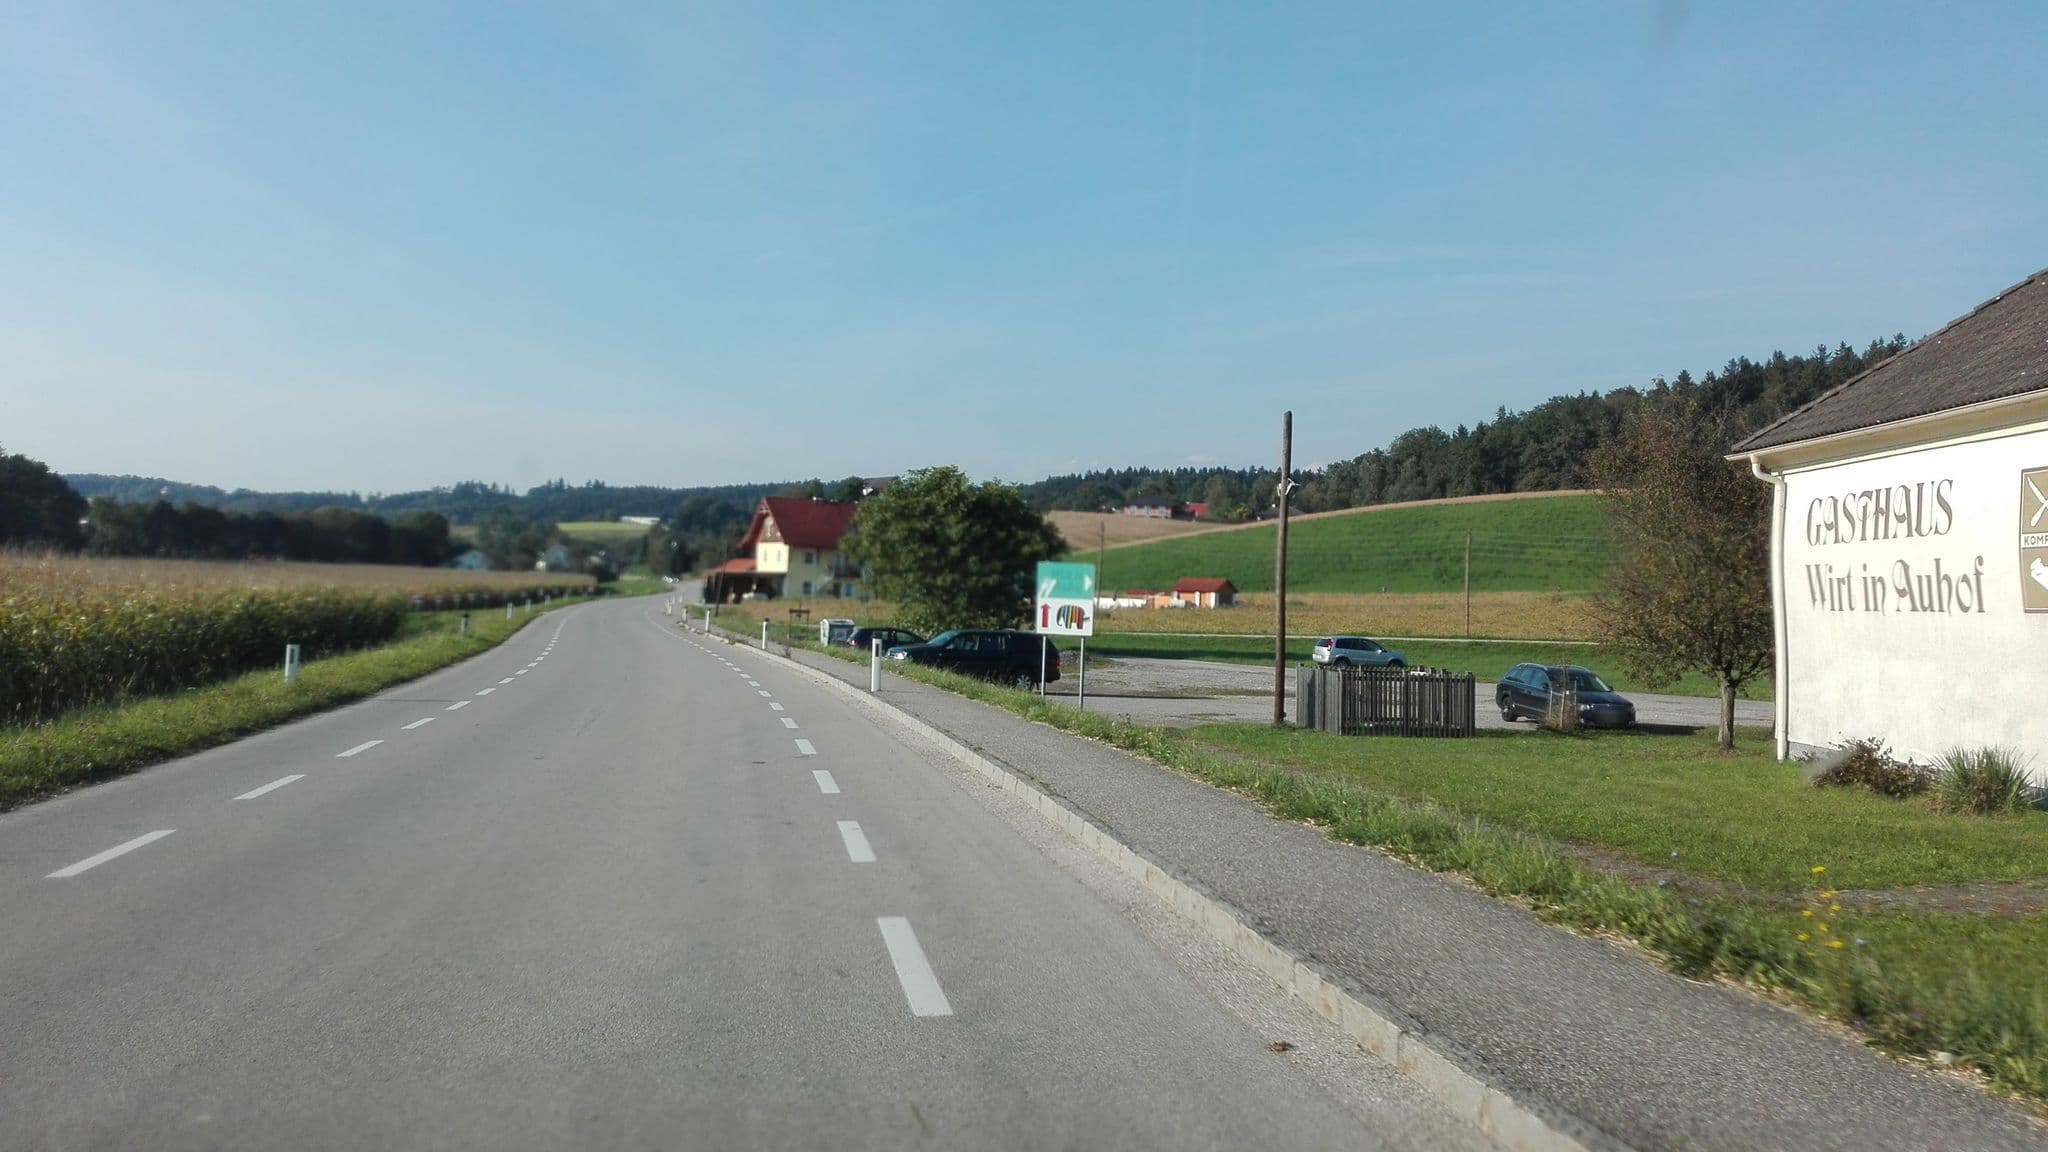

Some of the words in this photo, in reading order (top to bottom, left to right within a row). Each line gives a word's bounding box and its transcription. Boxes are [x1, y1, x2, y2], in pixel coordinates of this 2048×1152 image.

[1806, 479, 1953, 547] GASTHAUS
[1805, 562, 1855, 612] Wirt
[1862, 562, 1886, 616] in
[1892, 555, 1986, 615] Auhof
